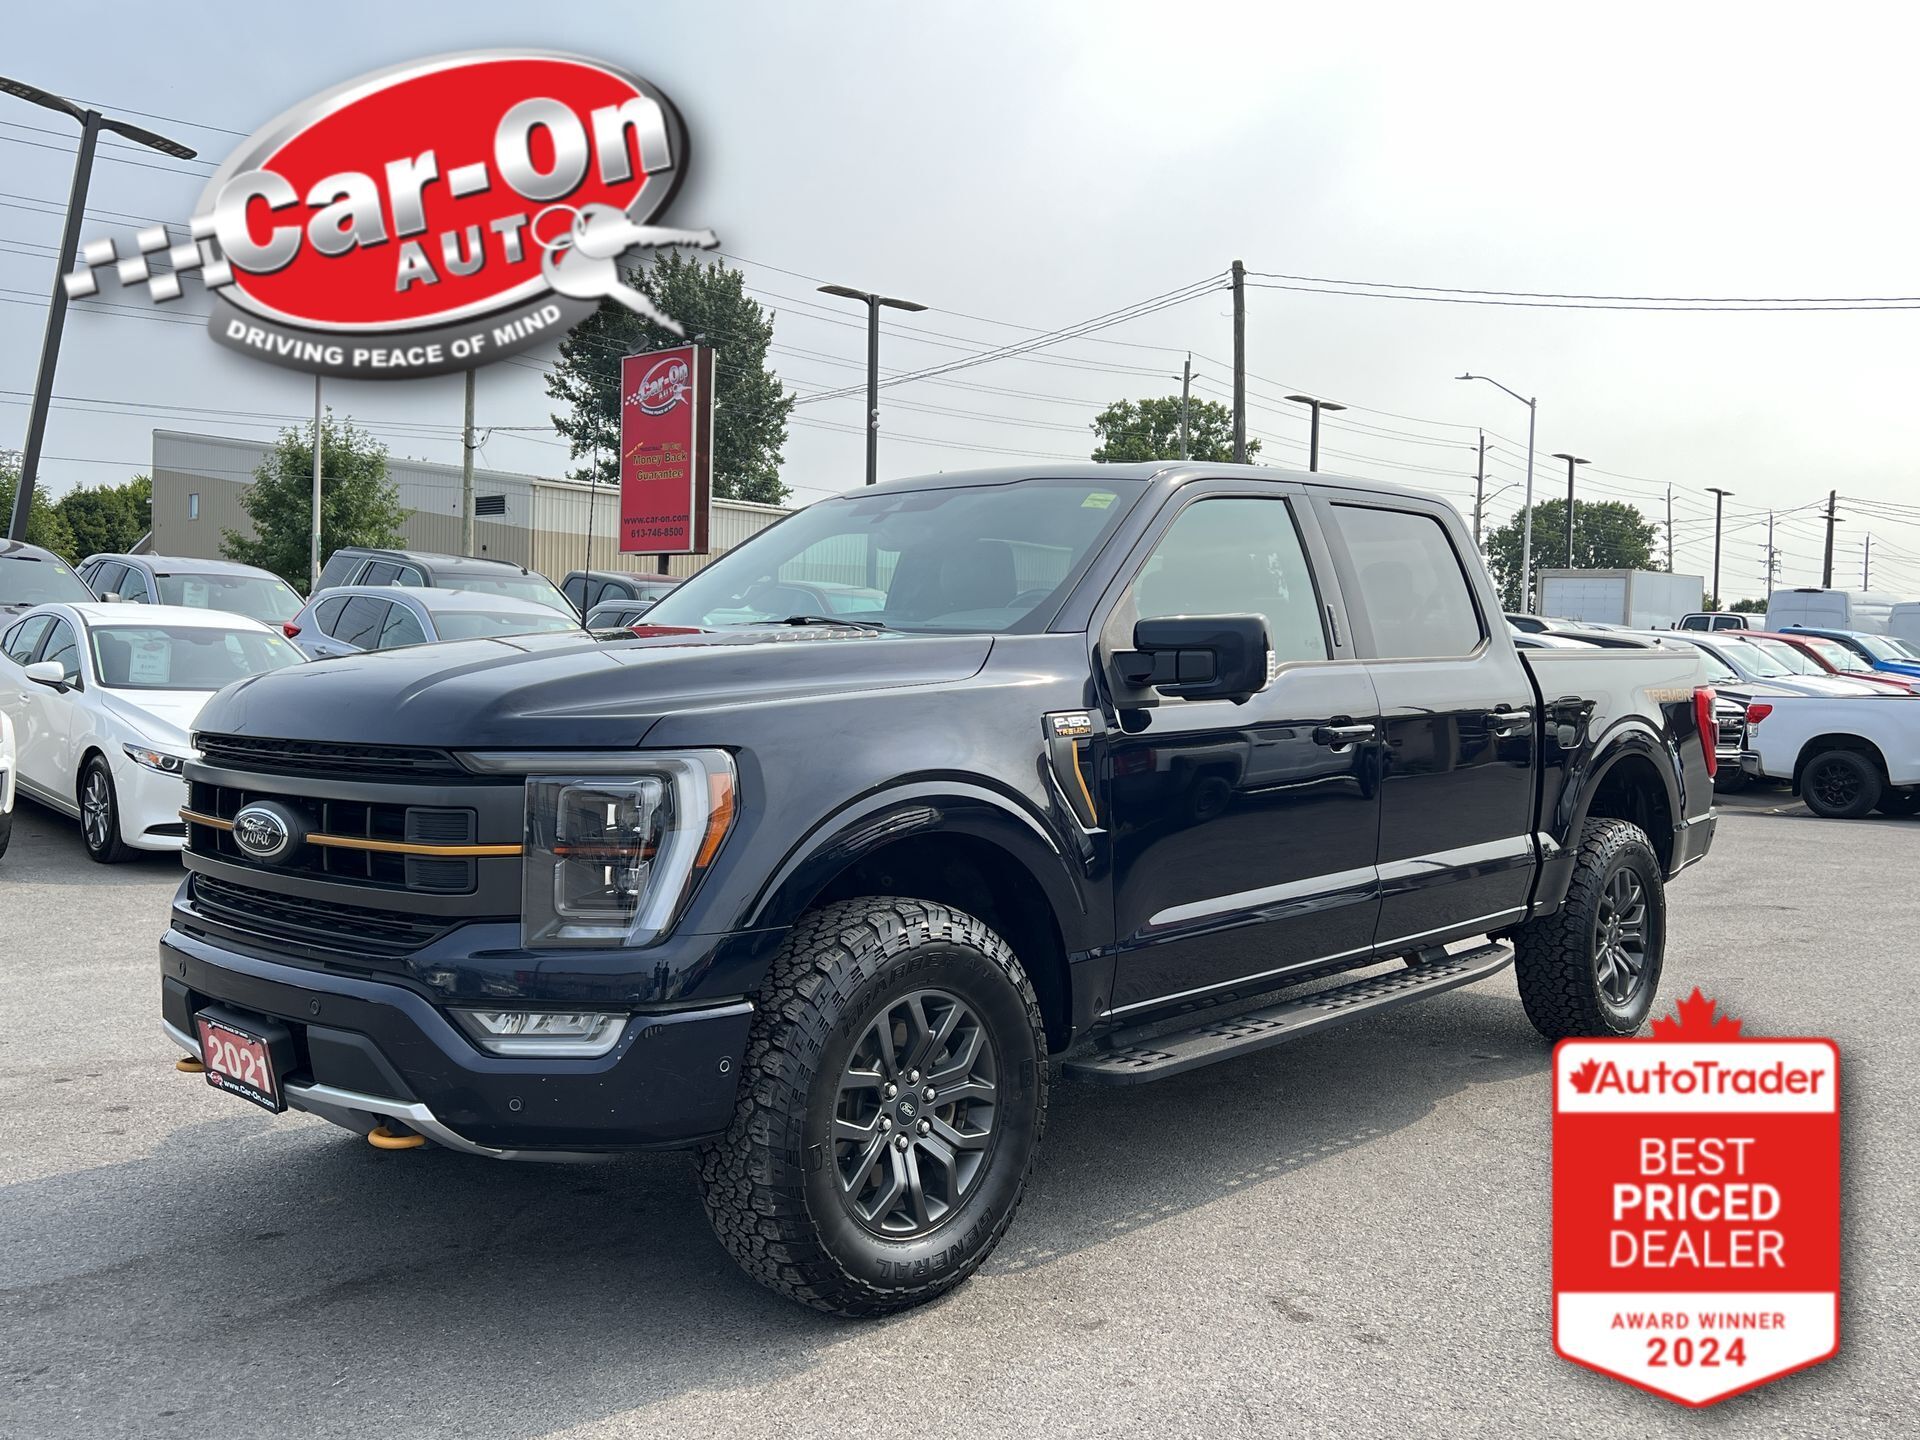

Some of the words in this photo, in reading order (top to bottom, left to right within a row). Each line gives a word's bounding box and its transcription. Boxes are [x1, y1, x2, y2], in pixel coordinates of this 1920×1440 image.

[638, 364, 688, 400] Car-On
[633, 455, 662, 467] Money
[664, 451, 688, 463] Back
[636, 469, 683, 481] Guarantee
[624, 514, 689, 524] www.car-on.com
[631, 527, 684, 538] 613-746-8500
[1644, 688, 1692, 702] TREMOR
[1054, 716, 1091, 728] F-150
[1056, 727, 1091, 736] TREMOR
[208, 1035, 271, 1095] 2021
[223, 1080, 275, 1109] www.Car-On.com
[877, 1206, 994, 1279] GENERAL
